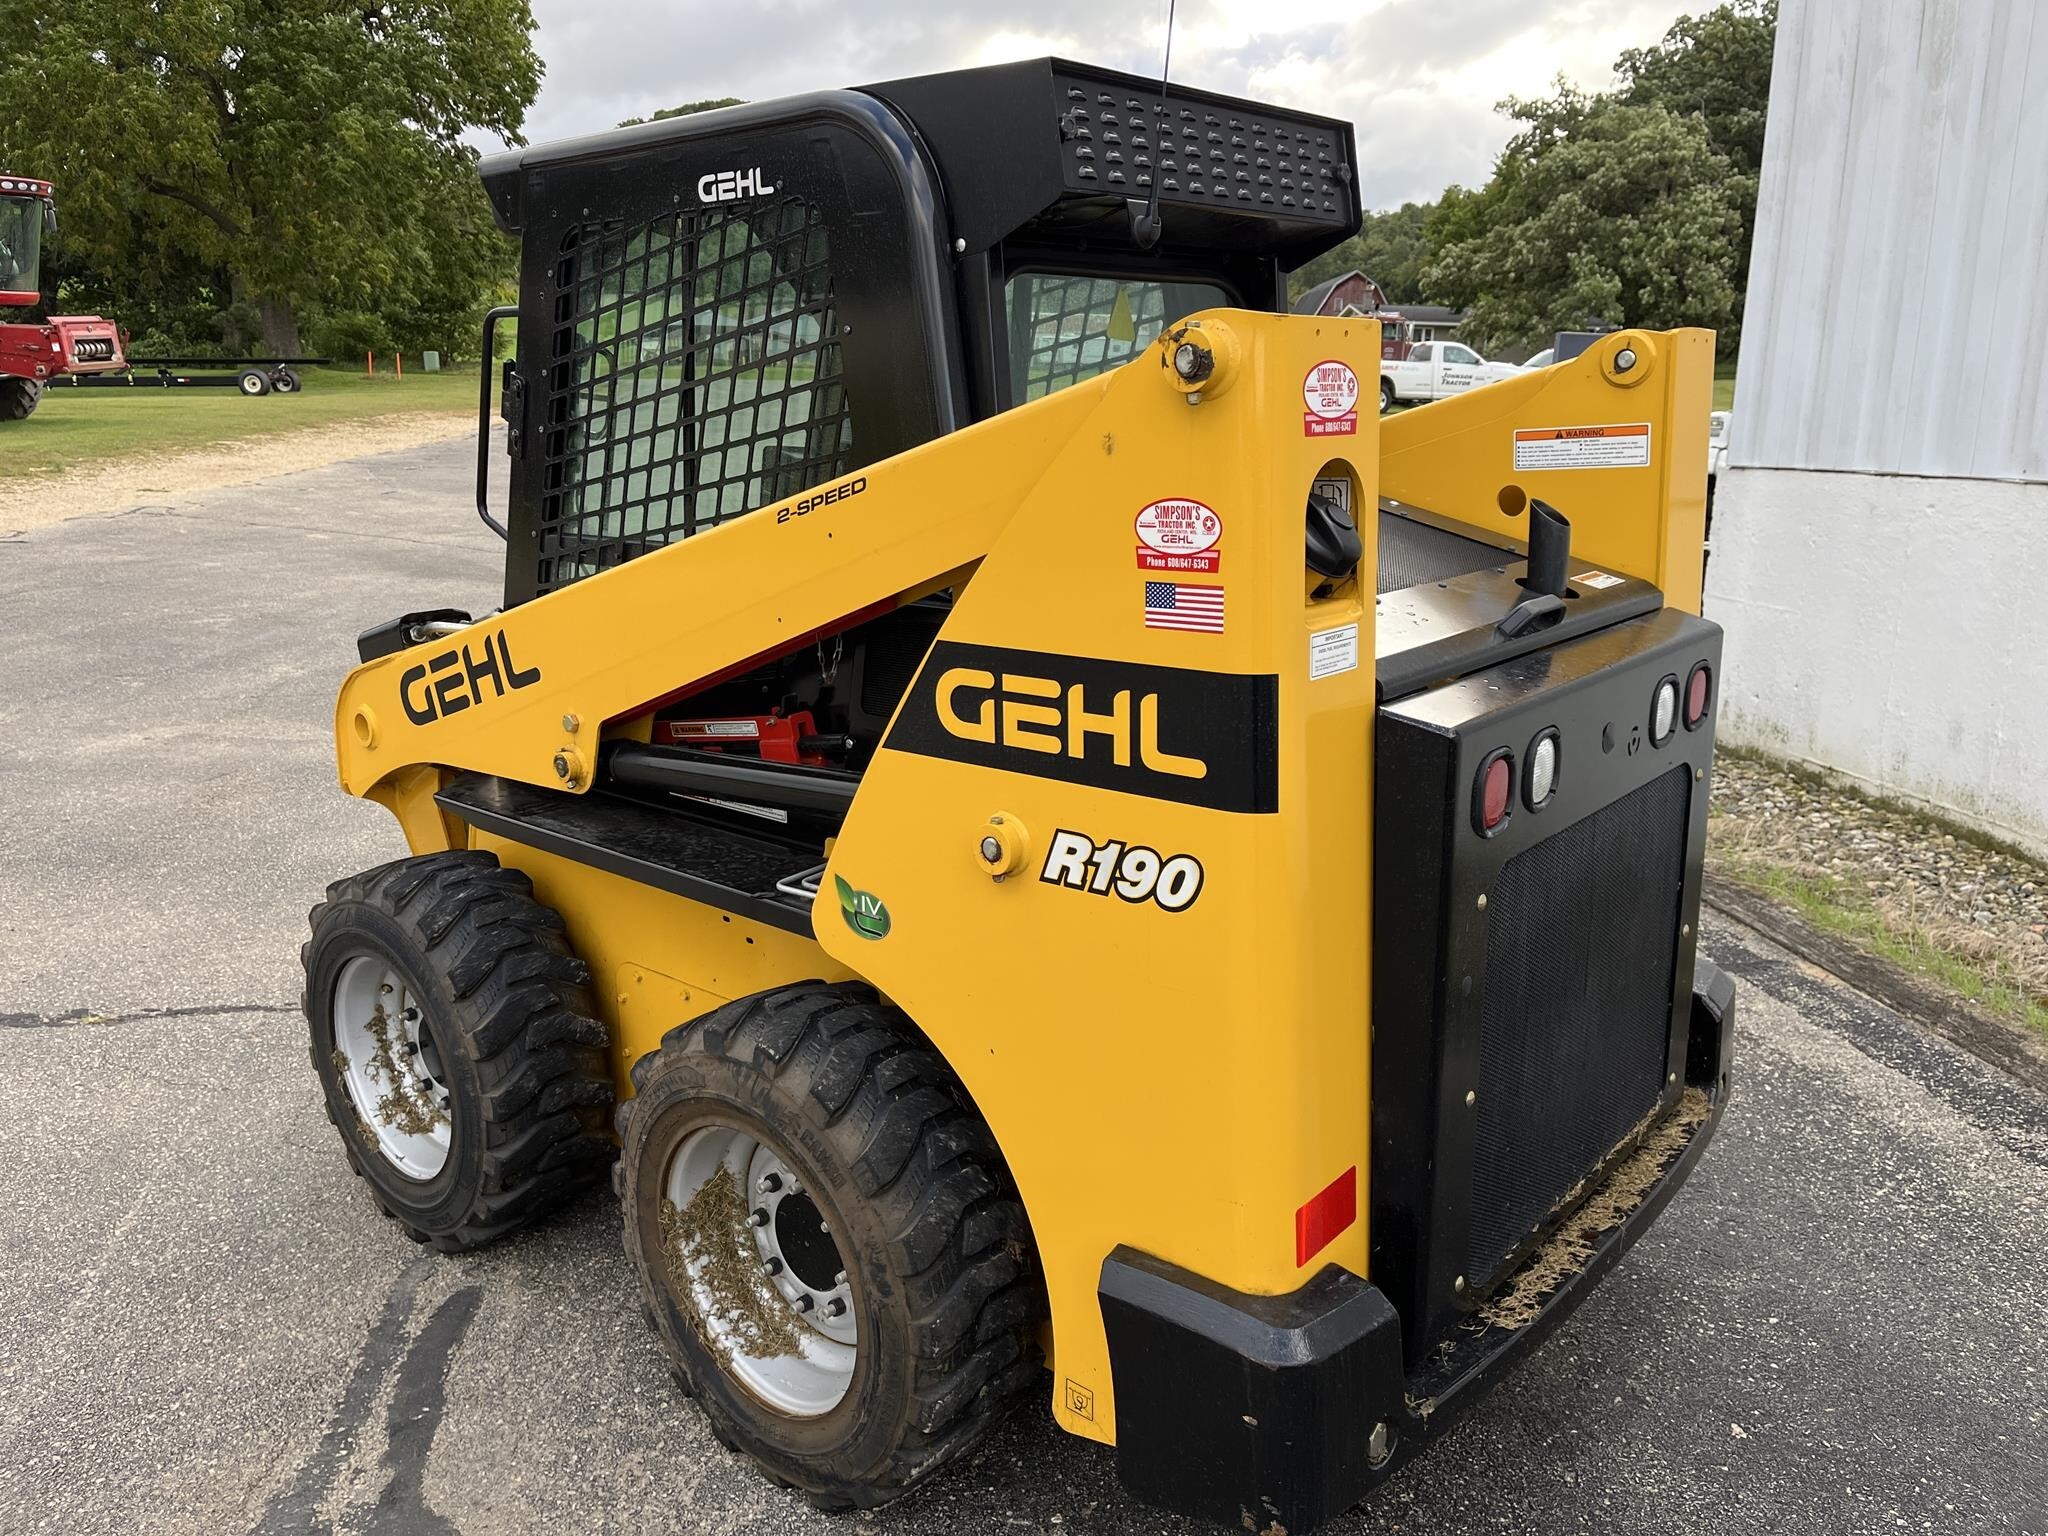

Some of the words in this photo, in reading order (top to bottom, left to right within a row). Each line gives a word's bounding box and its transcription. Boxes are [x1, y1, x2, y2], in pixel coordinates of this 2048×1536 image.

[698, 167, 774, 203] GEHL
[1318, 368, 1346, 382] SIMPSON'S
[1322, 398, 1341, 408] GEHL
[1565, 429, 1605, 438] WARNING
[777, 477, 867, 524] 2-SPEED
[1154, 505, 1200, 520] SIMPSON'S
[1158, 521, 1183, 529] TRACTOR
[1185, 521, 1198, 530] INC.
[1161, 534, 1194, 544] GEHL
[1147, 556, 1165, 567] Phone
[400, 629, 541, 726] GEHL
[935, 667, 1207, 779] GEHL
[1040, 828, 1204, 913] R190
[861, 895, 883, 916] IV
